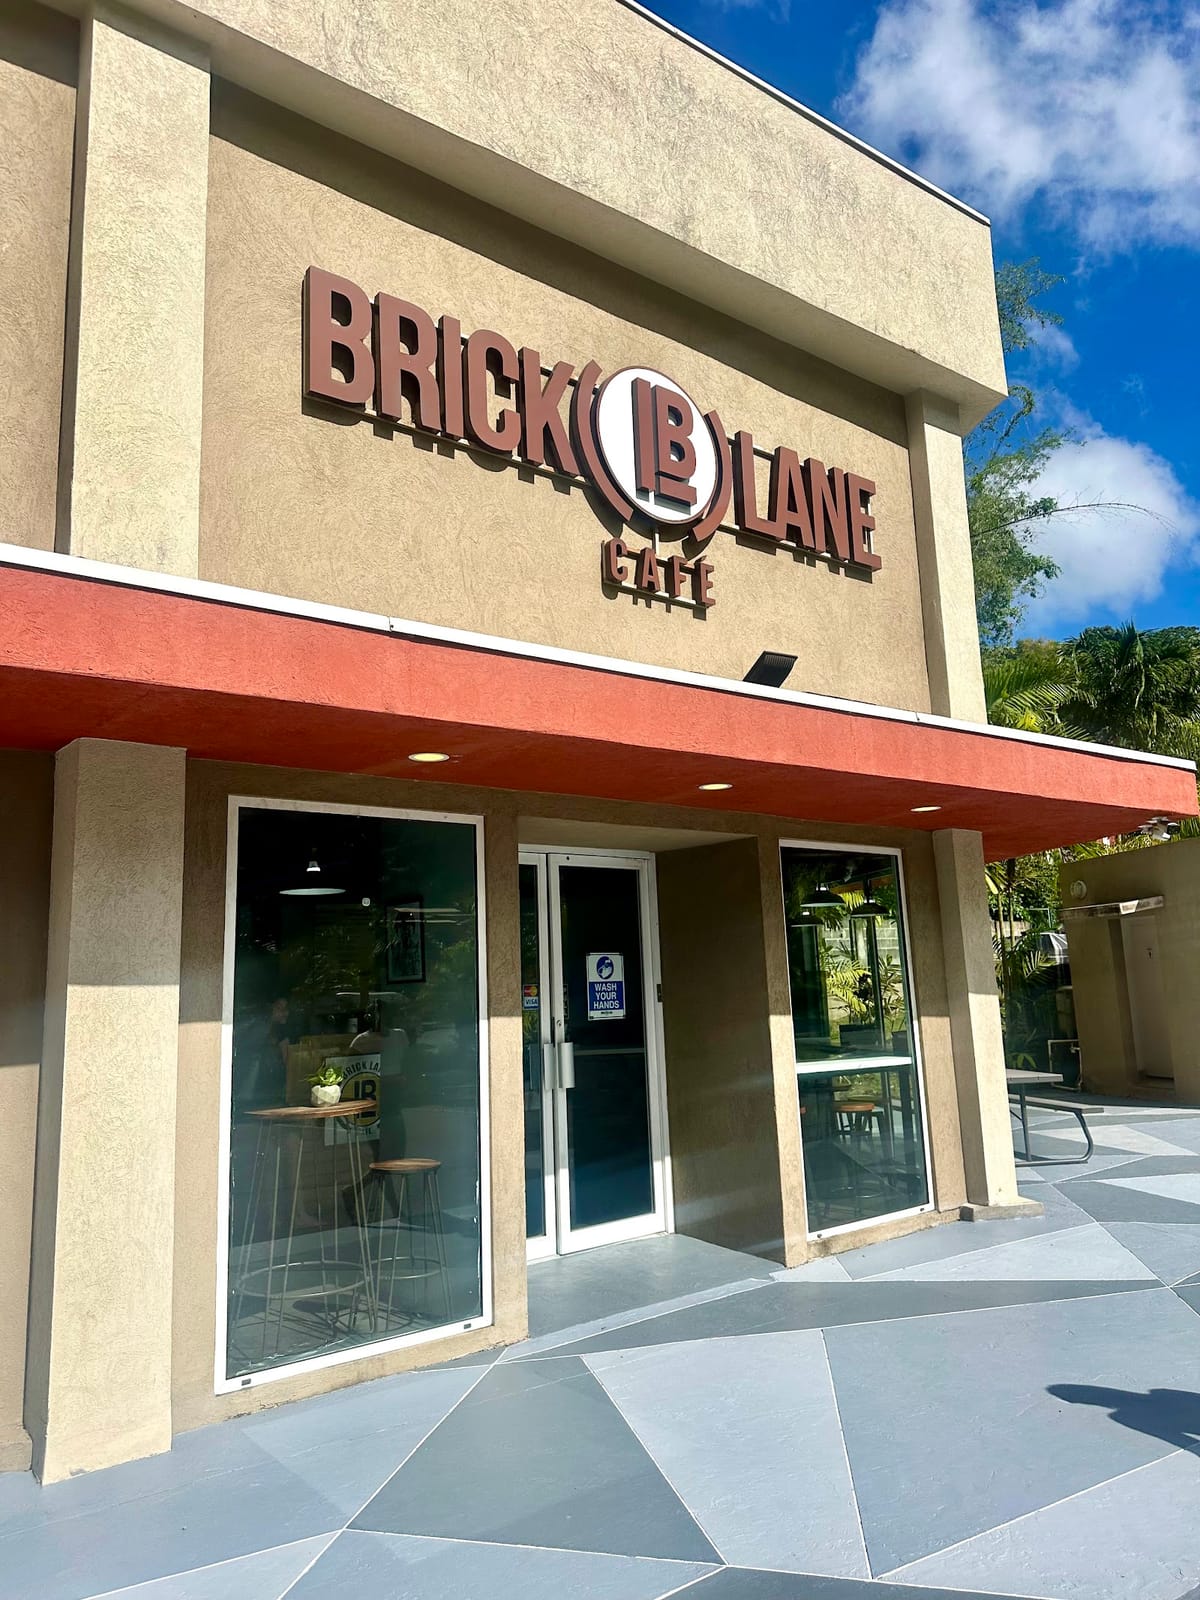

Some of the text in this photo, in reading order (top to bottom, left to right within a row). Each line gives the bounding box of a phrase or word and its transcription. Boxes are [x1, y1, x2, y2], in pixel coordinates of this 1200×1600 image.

[302, 265, 583, 478] BRICK
[734, 430, 883, 573] LANE
[595, 983, 617, 991] WASH
[596, 992, 617, 1000] YOUR
[594, 1001, 620, 1009] HANDS
